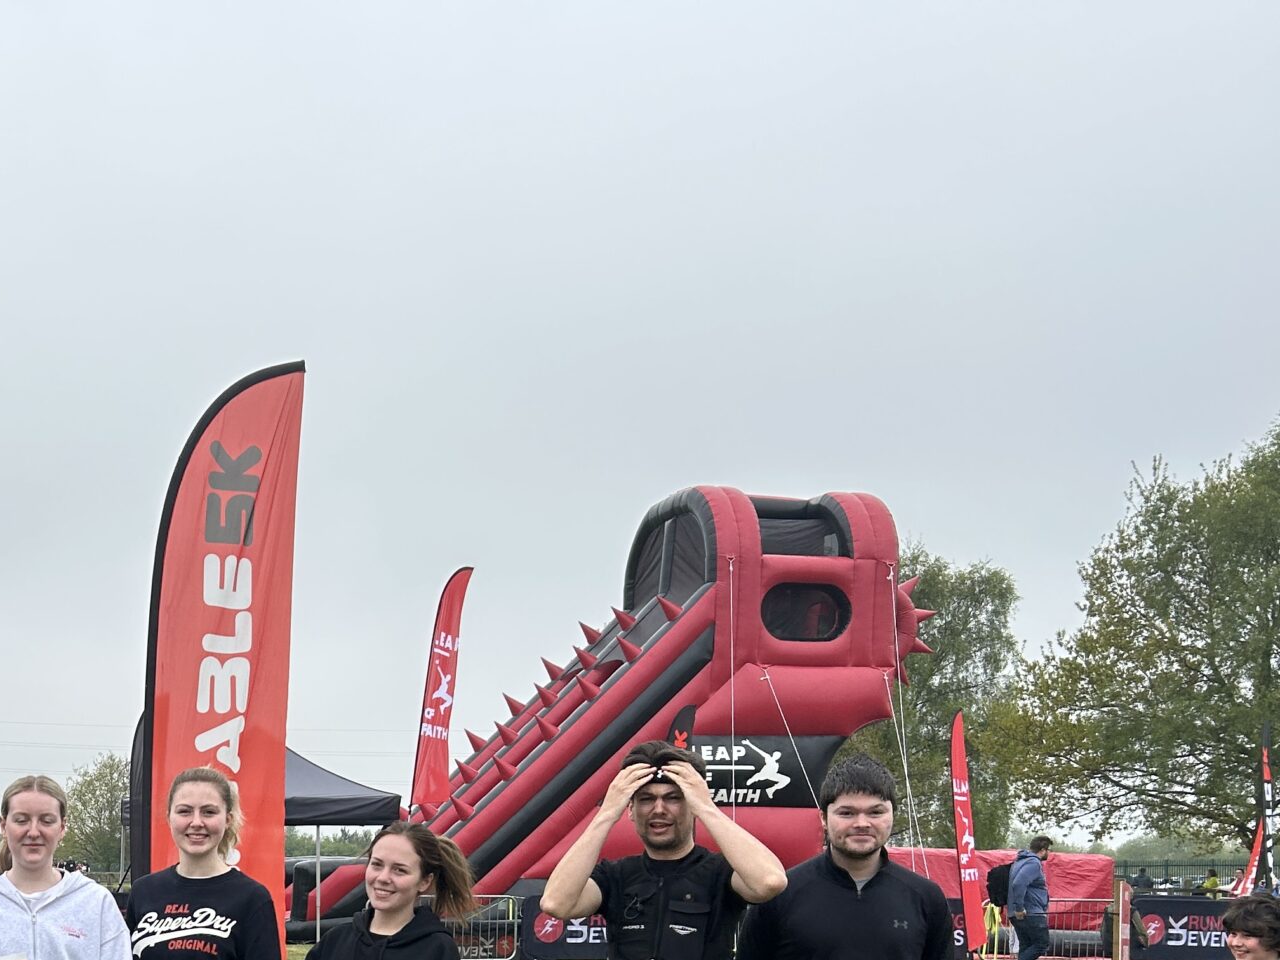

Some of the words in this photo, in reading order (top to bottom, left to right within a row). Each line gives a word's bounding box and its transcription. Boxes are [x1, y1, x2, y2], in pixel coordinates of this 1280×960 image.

[195, 440, 262, 866] ABLE5K
[692, 746, 746, 760] EAP
[165, 904, 189, 914] REAL
[168, 940, 218, 955] ORIGINAL
